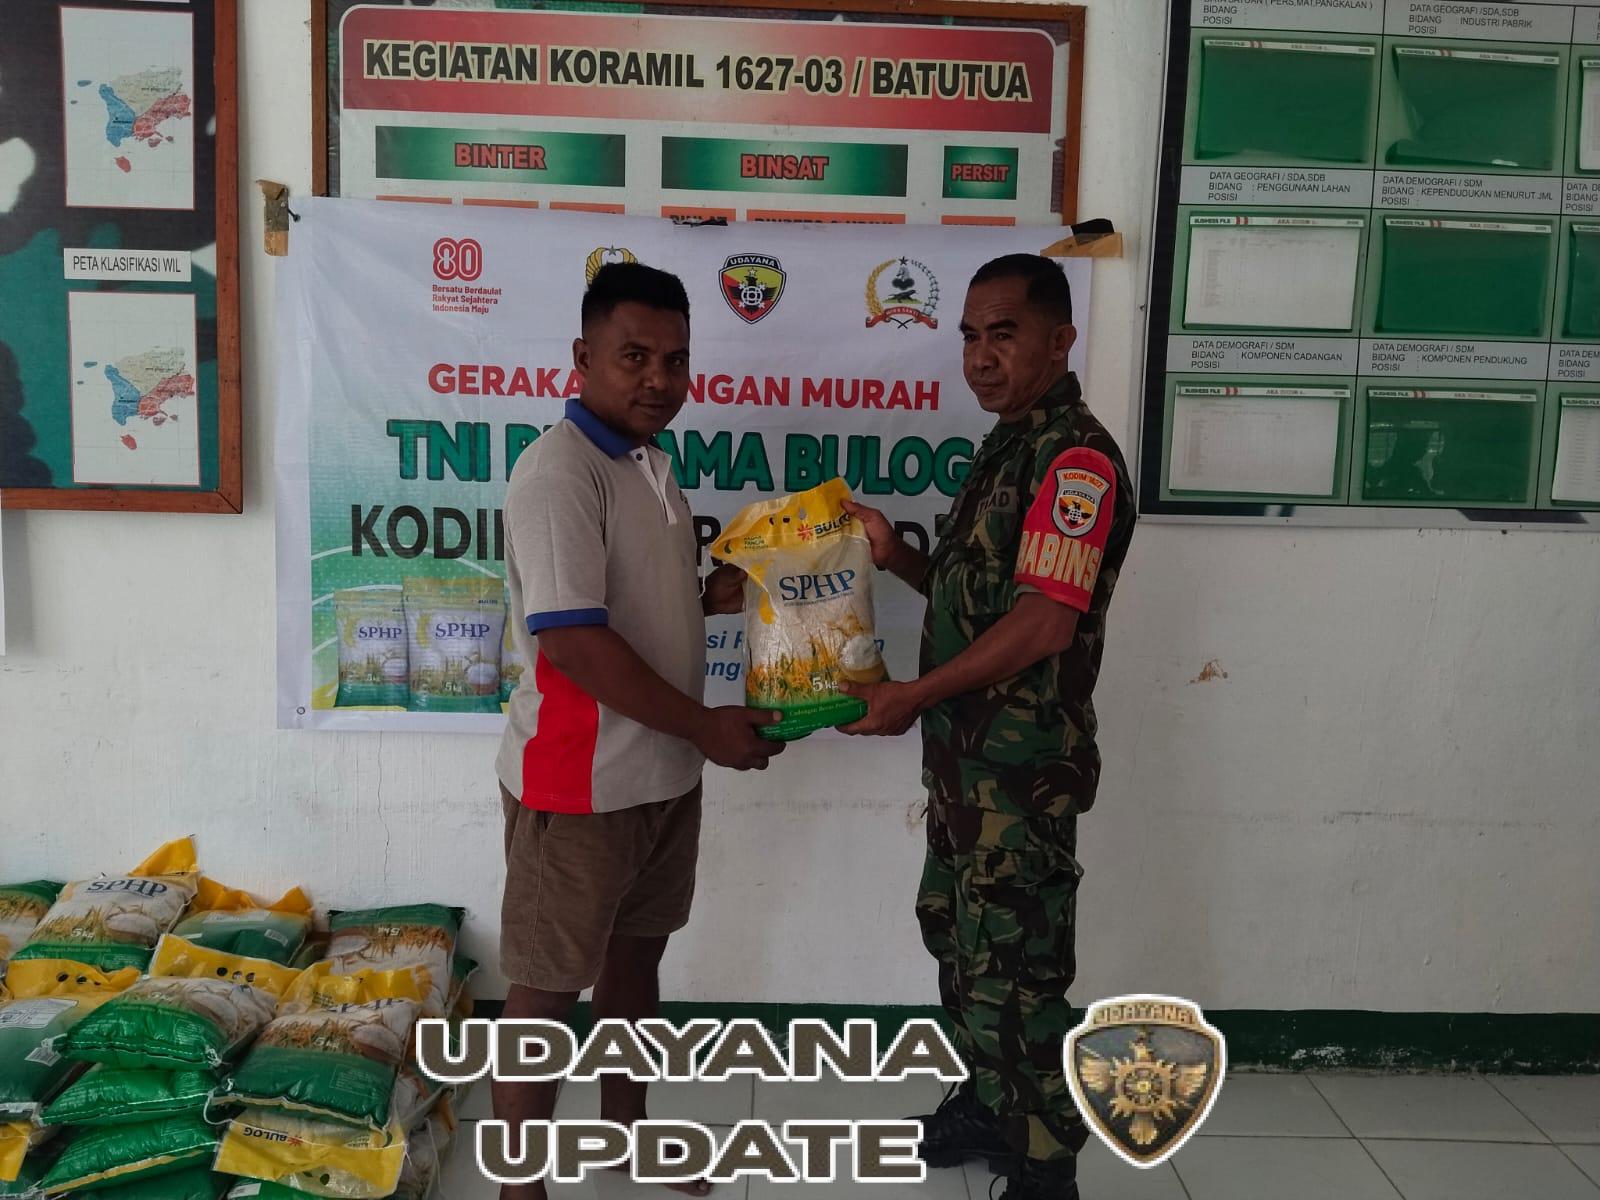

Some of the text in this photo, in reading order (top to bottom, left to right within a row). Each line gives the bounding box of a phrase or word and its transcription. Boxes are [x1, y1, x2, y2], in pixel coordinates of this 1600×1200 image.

[1203, 5, 1238, 14] BIDANG
[1409, 4, 1431, 12] DATA
[1433, 5, 1478, 14] GEOGRAFI
[1203, 16, 1233, 24] POSISI
[1409, 15, 1533, 28] BIDANG INDUSTRI PABRIK
[1408, 25, 1437, 34] POSISI
[365, 40, 1030, 100] KEGIATAN KORAMIL 1627-03 / BATUTUA
[455, 143, 547, 170] BINTER
[740, 154, 829, 180] BINSAT
[951, 163, 1010, 182] PERSIT
[1209, 171, 1232, 180] DATA
[1234, 172, 1280, 181] GEOGRAFI
[1383, 176, 1404, 185] DATA
[1405, 176, 1457, 187] DEMOGRAFI
[1464, 179, 1483, 187] SDM
[1209, 182, 1243, 191] BIDANG
[1256, 183, 1320, 192] PENGGUNAAN
[1321, 184, 1351, 193] LAHAN
[1566, 183, 1588, 191] DATA
[1208, 193, 1238, 201] POSISI
[1382, 187, 1414, 196] BIDANG
[1421, 189, 1492, 198] KEPENDUDUKAN
[1494, 191, 1535, 200] MENURUT
[1566, 193, 1598, 202] BIDANG
[1381, 197, 1410, 206] POSISI
[1565, 204, 1593, 212] POSISI
[73, 255, 182, 273] PETA KLASIFIKASI WIL
[432, 236, 483, 282] 80
[729, 255, 776, 268] UDAYANA
[432, 284, 502, 296] Bersatu Berdaulat
[432, 294, 498, 305] Rakyat Sejahtera
[432, 303, 489, 315] Indonesia Maju
[1192, 341, 1214, 349] DATA
[1215, 341, 1268, 350] DEMOGRAFI
[1275, 342, 1295, 350] SDM
[1372, 343, 1395, 351] DATA
[1396, 344, 1449, 353] DEMOGRAFI
[1455, 345, 1475, 353] SDM
[1191, 351, 1225, 359] BIDANG
[1241, 352, 1292, 361] KOMPONEN
[1293, 352, 1343, 361] CADANGAN
[1371, 354, 1406, 362] BIDANG
[1421, 355, 1472, 364] KOMPONEN
[1473, 356, 1528, 365] PENDUKUNG
[1191, 361, 1220, 369] POSISI
[1371, 363, 1400, 371] POSISI
[1558, 360, 1591, 368] BIDANG
[428, 363, 940, 410] GERAKA NGAN MURAH
[386, 418, 491, 482] TNI
[784, 433, 975, 497] BULOG
[351, 504, 505, 561] KODI
[1015, 531, 1103, 592] ABINS
[778, 569, 856, 601] SPHP
[358, 626, 402, 639] SPHP
[435, 622, 490, 638] SPHP
[812, 677, 839, 692] 5 kg
[86, 879, 168, 897] SPHP
[243, 1126, 288, 1142] BULOG
